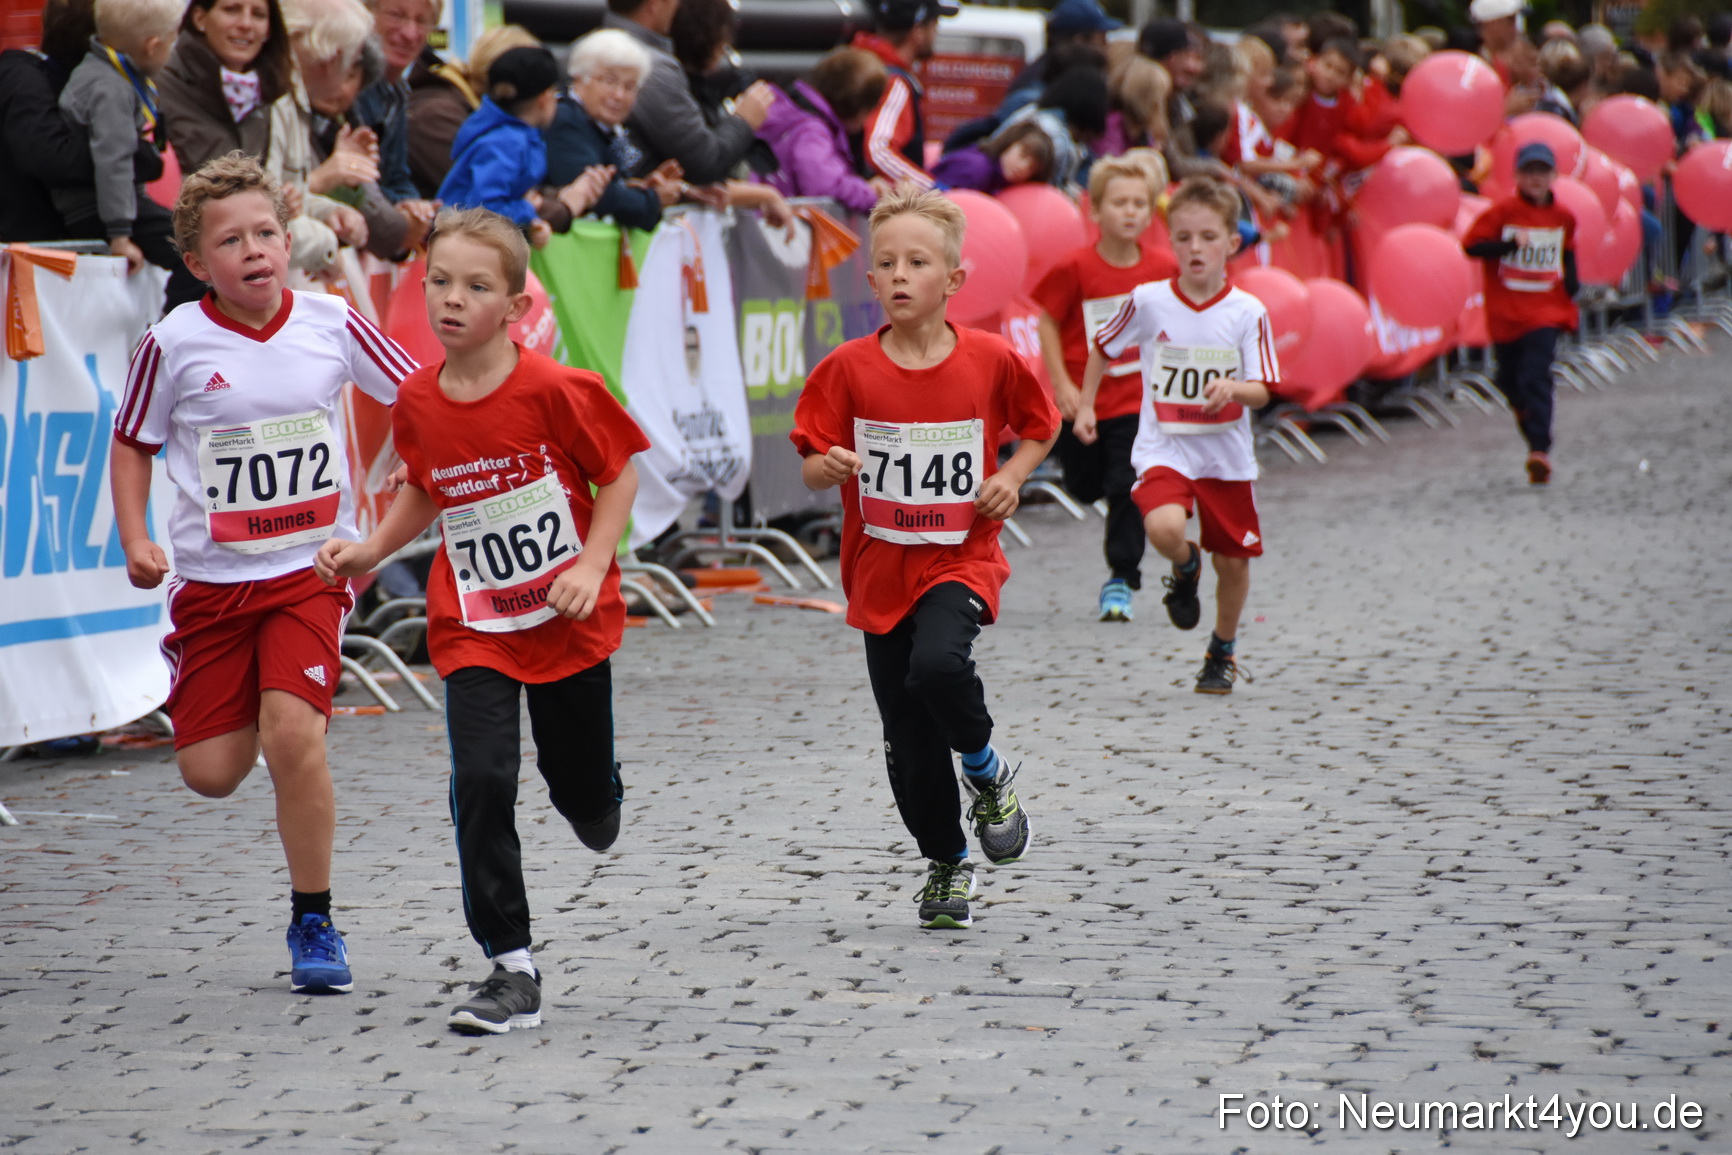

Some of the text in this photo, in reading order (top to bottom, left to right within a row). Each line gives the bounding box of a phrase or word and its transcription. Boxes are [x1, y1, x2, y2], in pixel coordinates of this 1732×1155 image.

[204, 382, 231, 393] adidas
[261, 414, 324, 440] BOCK
[863, 433, 902, 444] NeuerMarkt
[910, 425, 974, 442] BOCK
[208, 437, 255, 449] NeuerMarkt
[215, 442, 333, 504] 7072
[431, 456, 511, 482] Neumarkter
[868, 449, 974, 497] 7148
[483, 482, 552, 520] BOCK
[247, 509, 316, 535] Hannes
[447, 518, 482, 532] NeuerMarkt
[894, 508, 945, 528] Quirin
[454, 511, 569, 583] 7062
[491, 574, 558, 614] Christo
